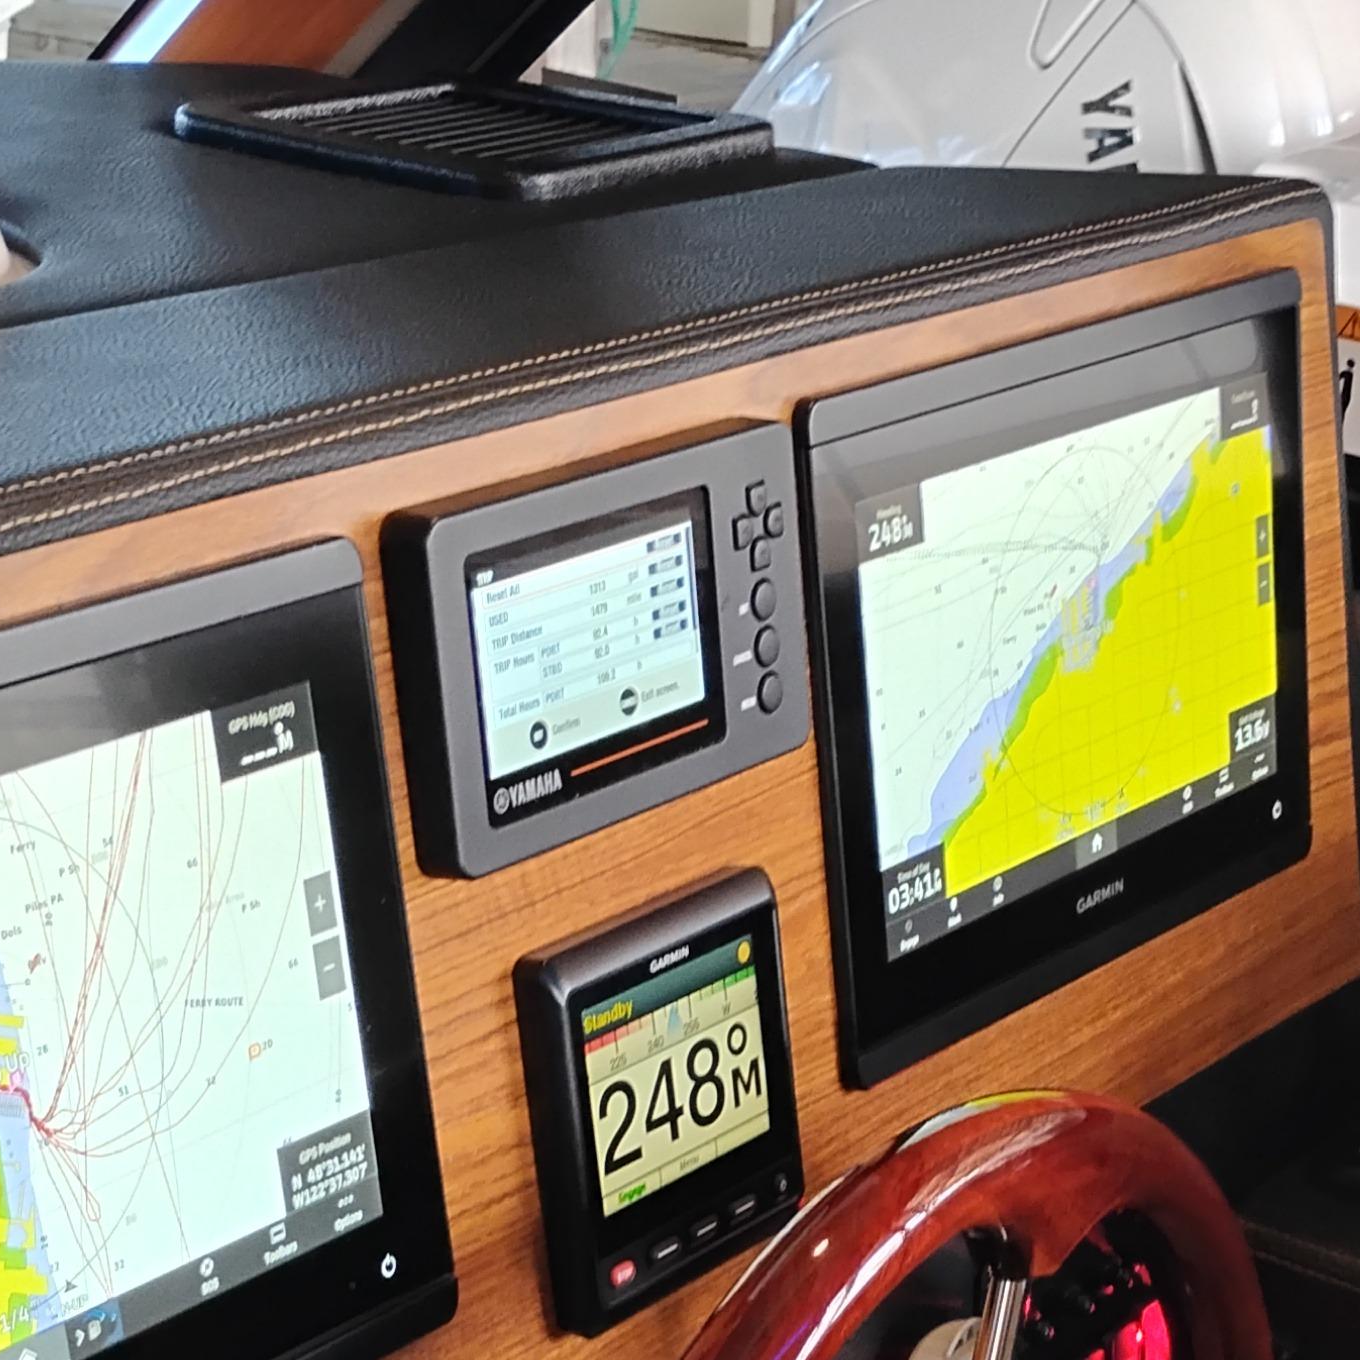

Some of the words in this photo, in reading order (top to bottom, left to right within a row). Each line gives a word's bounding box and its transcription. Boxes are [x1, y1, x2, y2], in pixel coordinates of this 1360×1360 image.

[1081, 79, 1138, 170] YA
[489, 611, 509, 627] USED
[510, 625, 543, 645] Distance
[510, 768, 563, 808] YAMAHA
[10, 839, 37, 855] Ferry
[1076, 878, 1124, 915] GARMIN
[650, 945, 690, 974] GARMIN
[214, 996, 245, 1008] ROUTE
[583, 1000, 633, 1035] Standby
[4, 1051, 31, 1073] Up
[292, 1174, 303, 1192] N
